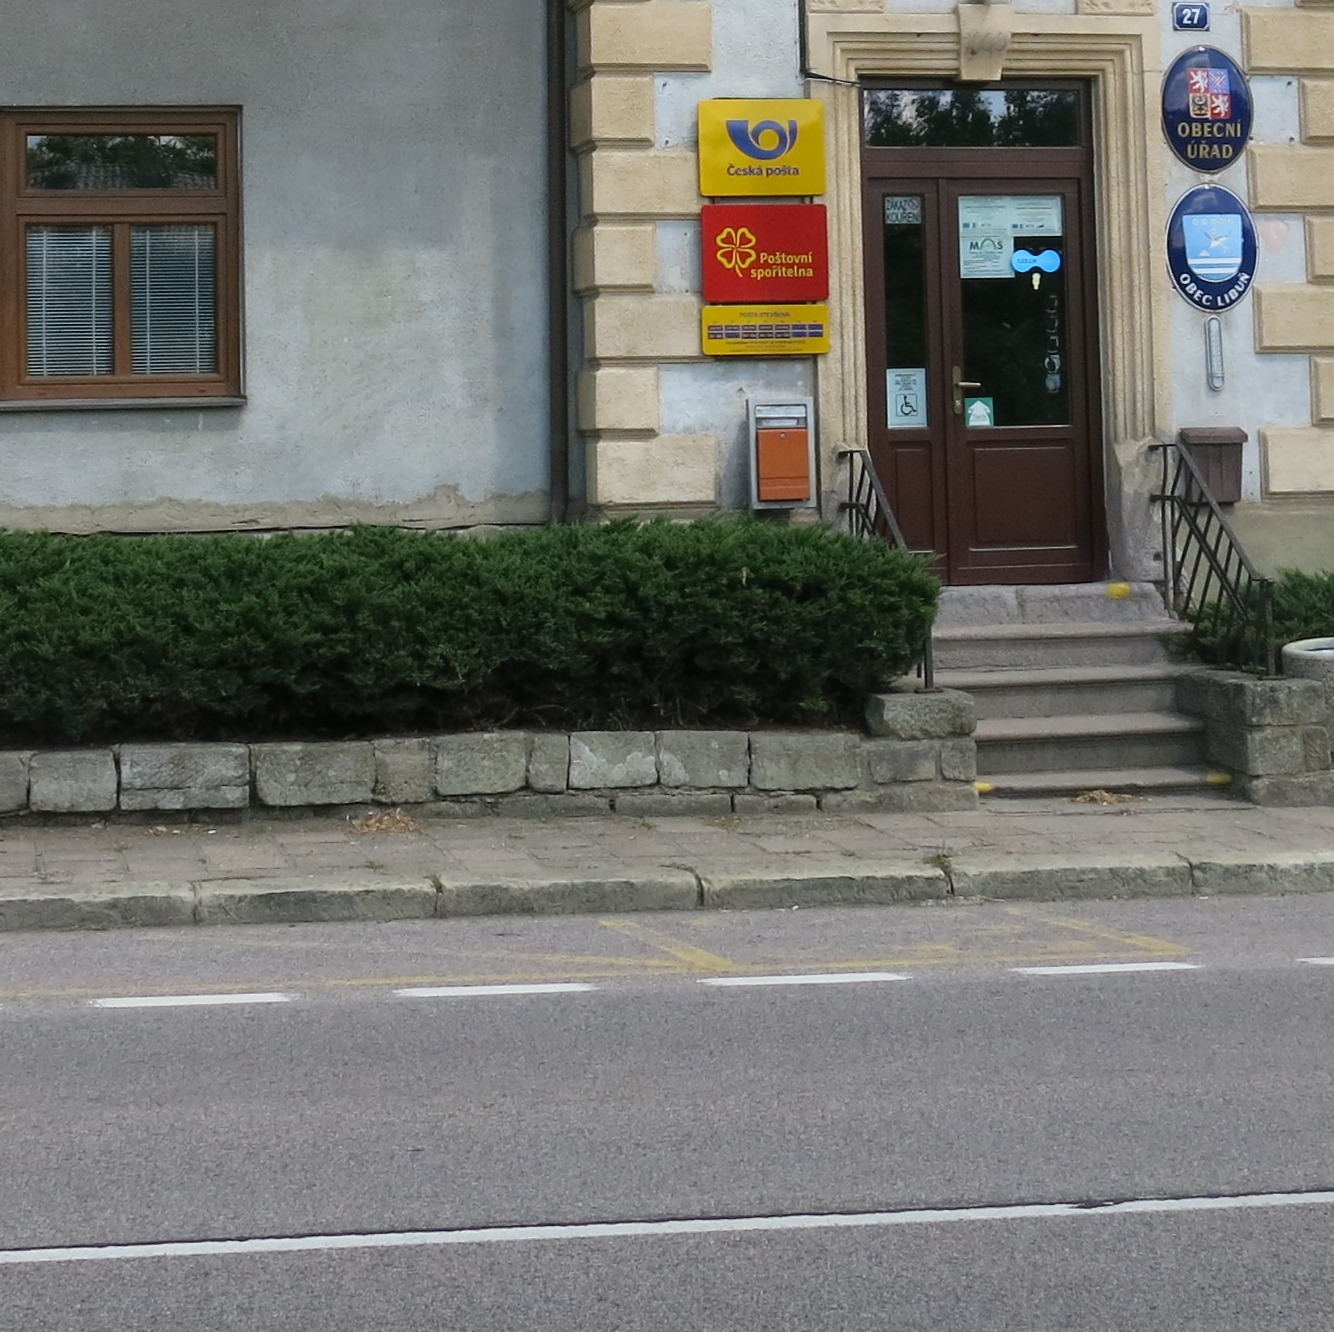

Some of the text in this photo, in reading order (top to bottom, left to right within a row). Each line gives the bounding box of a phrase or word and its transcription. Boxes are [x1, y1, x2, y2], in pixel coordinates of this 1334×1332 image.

[1182, 8, 1201, 24] 27
[1177, 118, 1242, 138] OBECNÍ
[1187, 140, 1234, 159] ÚŘAD
[727, 164, 800, 177] Česká pošta
[759, 251, 813, 264] Poštovní
[750, 265, 814, 280] spořitelna
[1179, 272, 1250, 307] OBEC LIBUŇ
